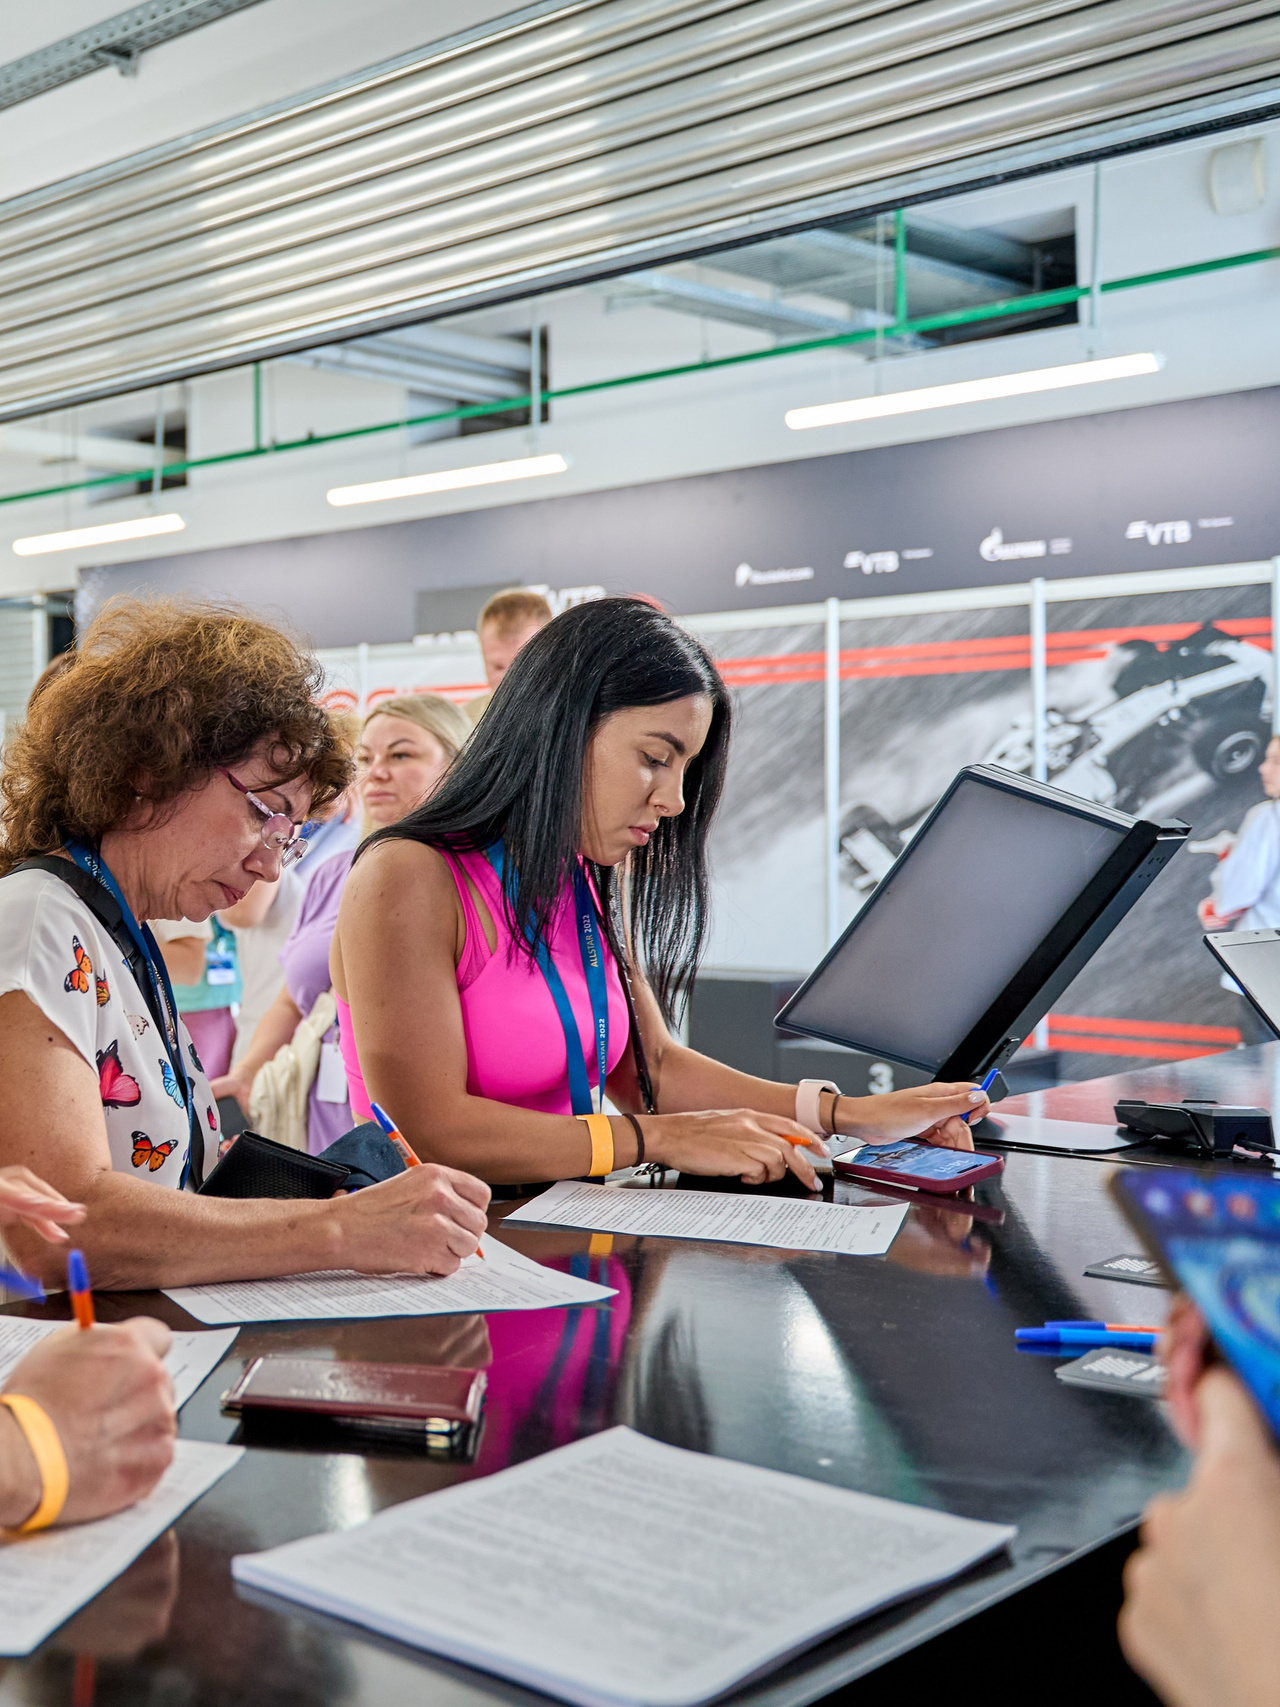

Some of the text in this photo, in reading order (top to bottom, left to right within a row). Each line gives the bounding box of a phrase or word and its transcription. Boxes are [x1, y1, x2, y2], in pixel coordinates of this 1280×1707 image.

[1146, 519, 1191, 545] VTB
[582, 914, 599, 968] ALLSTAR 2022
[598, 1018, 606, 1039] 2022
[868, 1062, 894, 1095] 3
